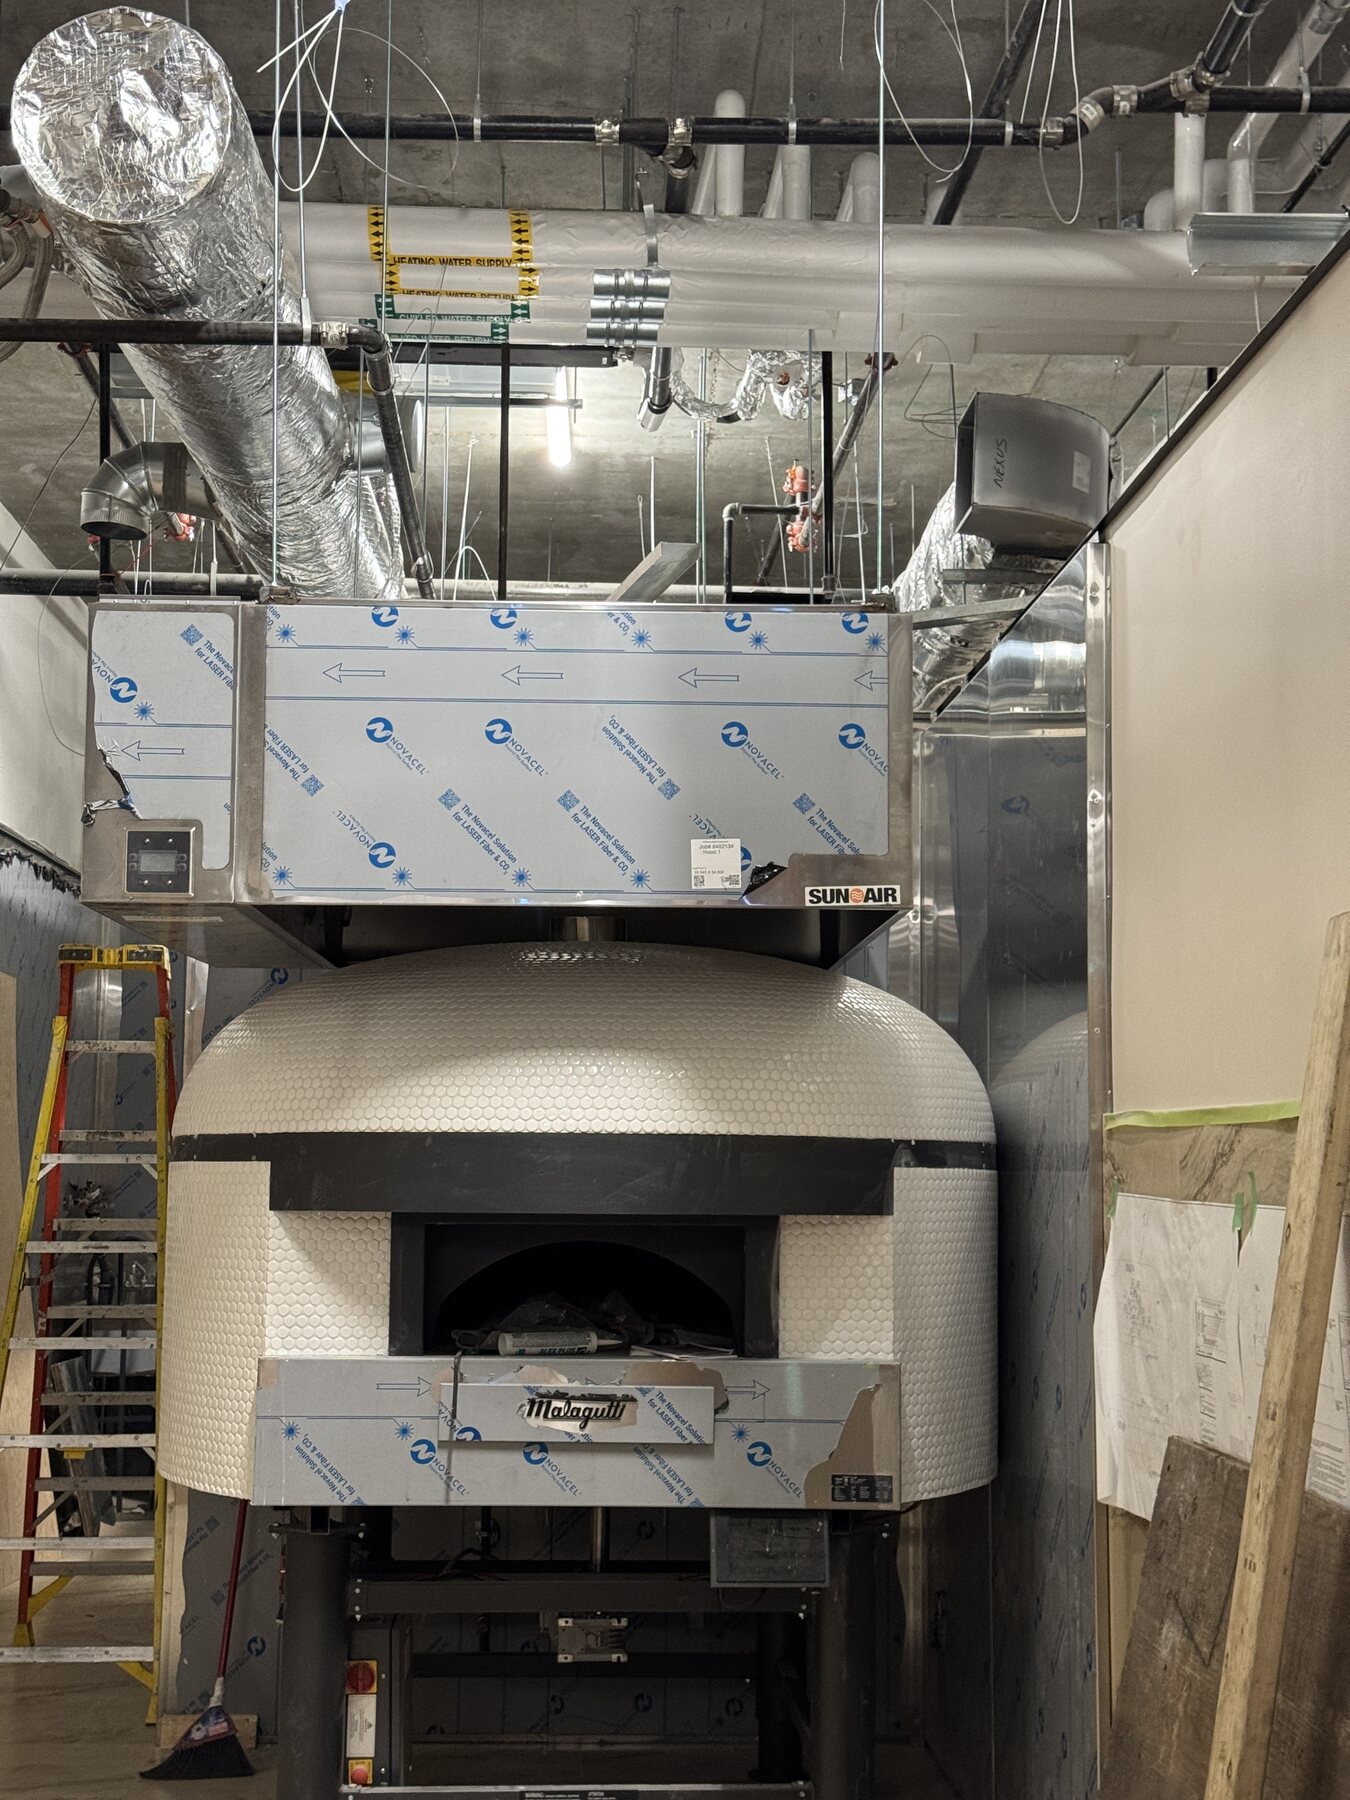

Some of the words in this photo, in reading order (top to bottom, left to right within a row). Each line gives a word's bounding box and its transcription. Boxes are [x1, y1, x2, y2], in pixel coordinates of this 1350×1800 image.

[441, 258, 472, 266] WATER
[476, 259, 513, 267] SUPPLY
[993, 438, 1008, 489] NEXUS
[195, 647, 205, 658] for
[203, 656, 225, 678] LASER
[204, 640, 216, 653] The
[214, 651, 234, 674] Novac
[91, 658, 114, 683] NOVA
[267, 729, 283, 745] Fiber
[601, 726, 625, 751] Solution
[618, 727, 625, 735] &
[623, 732, 639, 750] Fiber
[266, 746, 291, 770] Novacel
[280, 743, 301, 764] LASER
[390, 736, 426, 775] NOVACEL
[509, 738, 545, 776] NOVACEL
[623, 749, 647, 774] Novacel
[637, 747, 657, 768] LASER
[745, 741, 781, 780] NOVACEL
[862, 743, 888, 773] NOVAC
[289, 768, 300, 781] The
[299, 762, 309, 773] for
[645, 771, 657, 785] The
[655, 766, 666, 777] for
[336, 810, 372, 849] NOVACEL
[453, 811, 463, 823] for
[461, 820, 482, 842] LASER
[479, 839, 496, 857] Fiber
[462, 804, 473, 818] The
[471, 815, 496, 840] Novacel
[493, 837, 517, 863] Solution
[571, 812, 582, 824] for
[580, 821, 601, 844] LASER
[598, 841, 614, 858] Fiber
[580, 805, 592, 819] The
[590, 816, 615, 841] Novacel
[612, 839, 636, 865] Solution
[807, 816, 818, 827] for
[815, 824, 837, 846] LASER
[816, 808, 828, 822] The
[826, 819, 851, 844] Novacel
[808, 888, 850, 904] SUN
[864, 887, 898, 903] AIR
[526, 1397, 627, 1430] Malagutti
[648, 1398, 657, 1408] for
[656, 1407, 675, 1428] LASER
[673, 1425, 688, 1442] Fiber
[656, 1391, 667, 1404] The
[665, 1402, 688, 1425] Novacel
[438, 1409, 459, 1432] NOVA
[294, 1445, 317, 1470] Solution
[315, 1452, 330, 1468] Fiber
[633, 1447, 656, 1471] Solution
[653, 1453, 668, 1469] Fiber
[314, 1468, 337, 1492] Novacel
[328, 1466, 347, 1486] LASER
[433, 1458, 466, 1496] NOVACEL
[545, 1459, 578, 1496] NOVACEL
[653, 1469, 676, 1493] Novacel
[666, 1467, 686, 1488] LASER
[769, 1460, 802, 1498] NOVACEL
[336, 1489, 347, 1503] The
[345, 1484, 356, 1495] for
[674, 1491, 685, 1504] The
[684, 1486, 694, 1497] for
